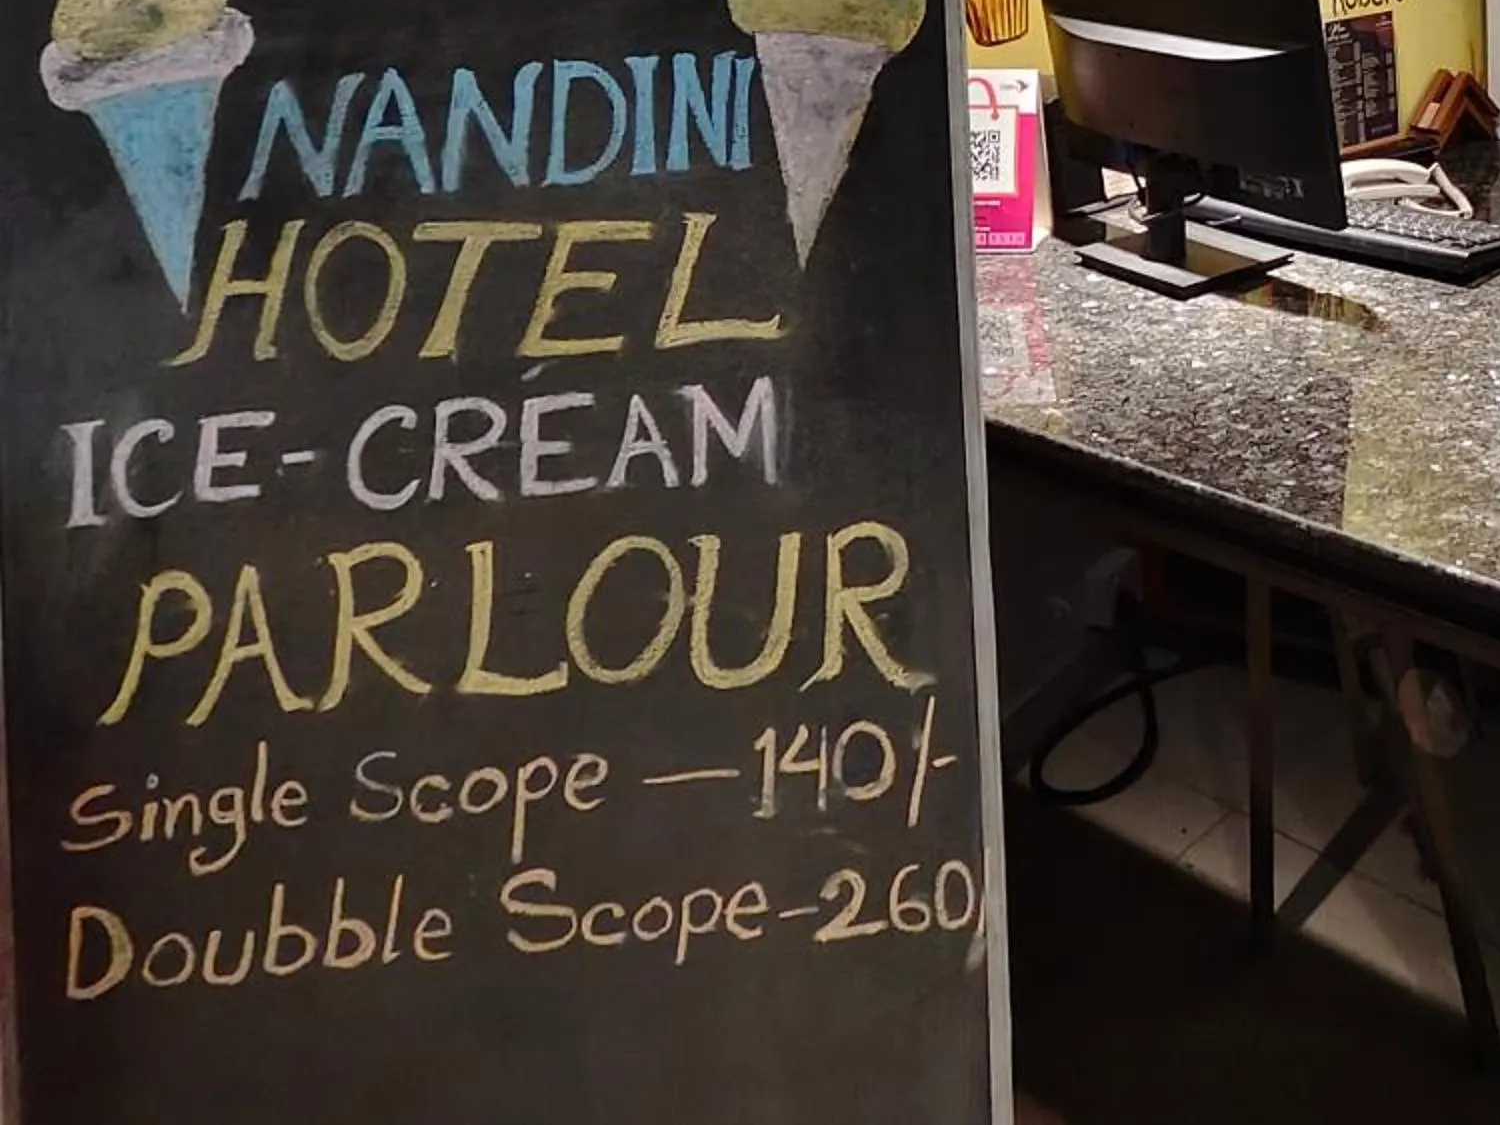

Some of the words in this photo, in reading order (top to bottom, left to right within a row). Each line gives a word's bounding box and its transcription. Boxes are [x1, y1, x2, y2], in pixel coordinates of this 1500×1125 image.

[239, 51, 760, 200] NANDINI
[164, 211, 790, 365] HOTEL
[96, 521, 940, 728] PARLOUR
[349, 750, 610, 863] Scope
[64, 875, 453, 1001] Doubble
